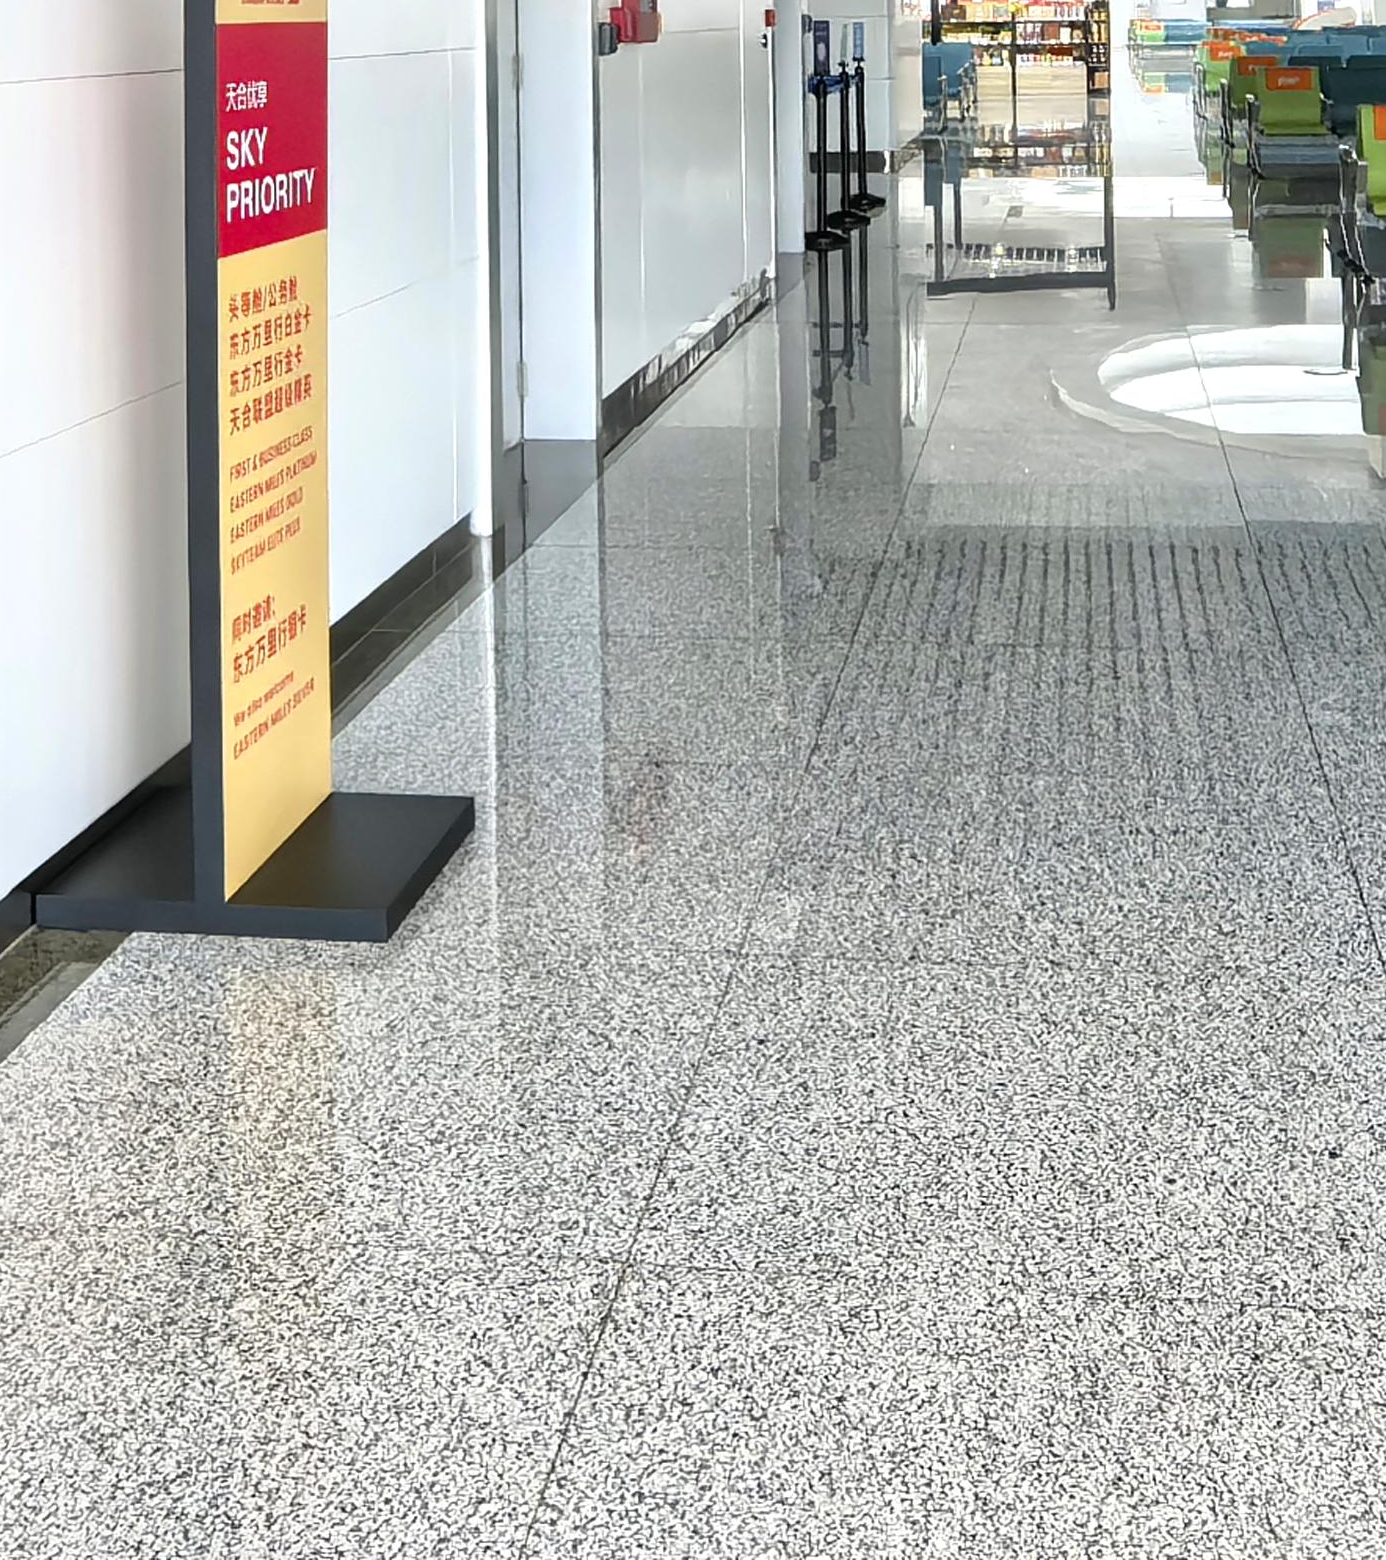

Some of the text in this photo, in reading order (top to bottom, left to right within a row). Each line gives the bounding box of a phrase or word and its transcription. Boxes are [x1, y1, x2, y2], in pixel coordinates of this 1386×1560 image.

[226, 126, 268, 171] SKY
[226, 167, 316, 224] PRIORITY
[229, 303, 313, 360] 东方万里行白金卡
[229, 343, 303, 397] 东方万里行金卡
[229, 482, 264, 513] EASTERN
[229, 513, 264, 544] EASTERN
